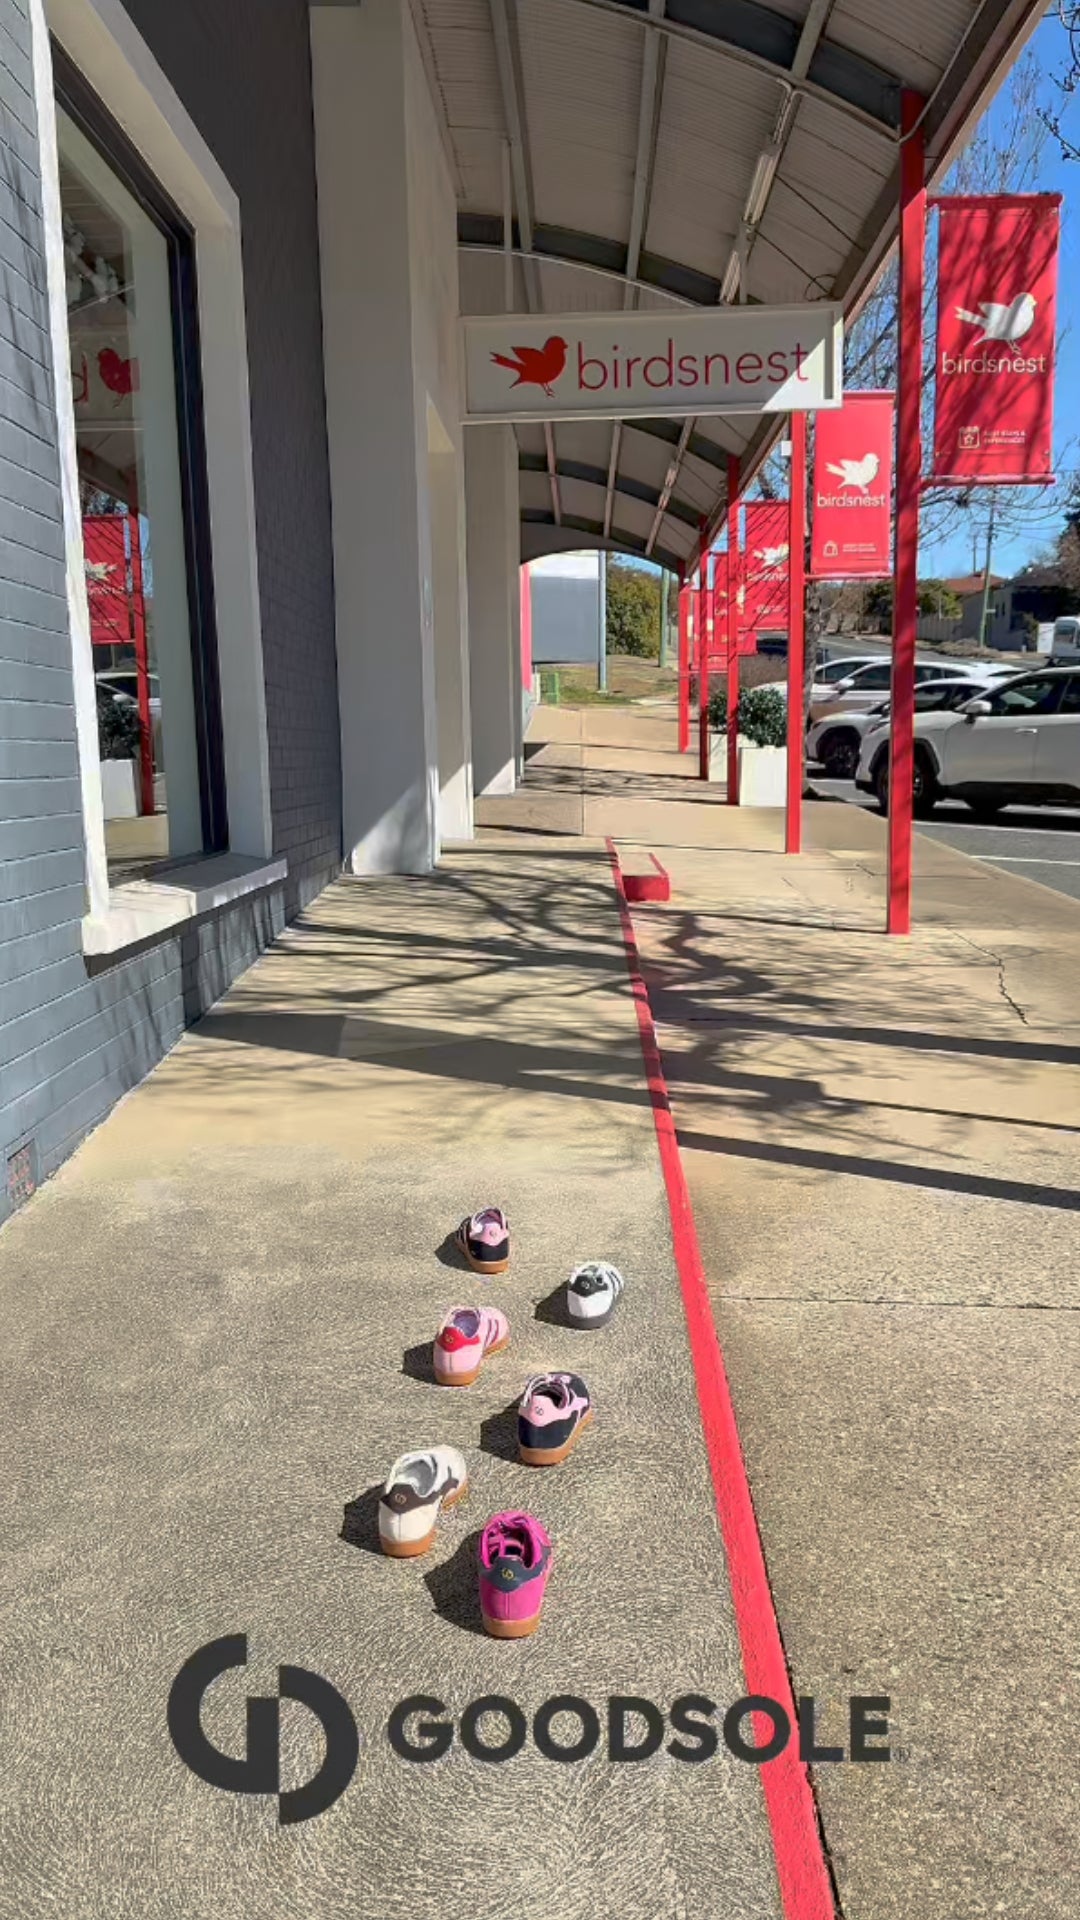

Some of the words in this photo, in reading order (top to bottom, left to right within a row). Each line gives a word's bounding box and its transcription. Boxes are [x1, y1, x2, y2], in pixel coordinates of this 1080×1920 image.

[577, 337, 810, 391] birdsnest
[941, 351, 1047, 375] birdsnest
[816, 490, 886, 508] birdsnest
